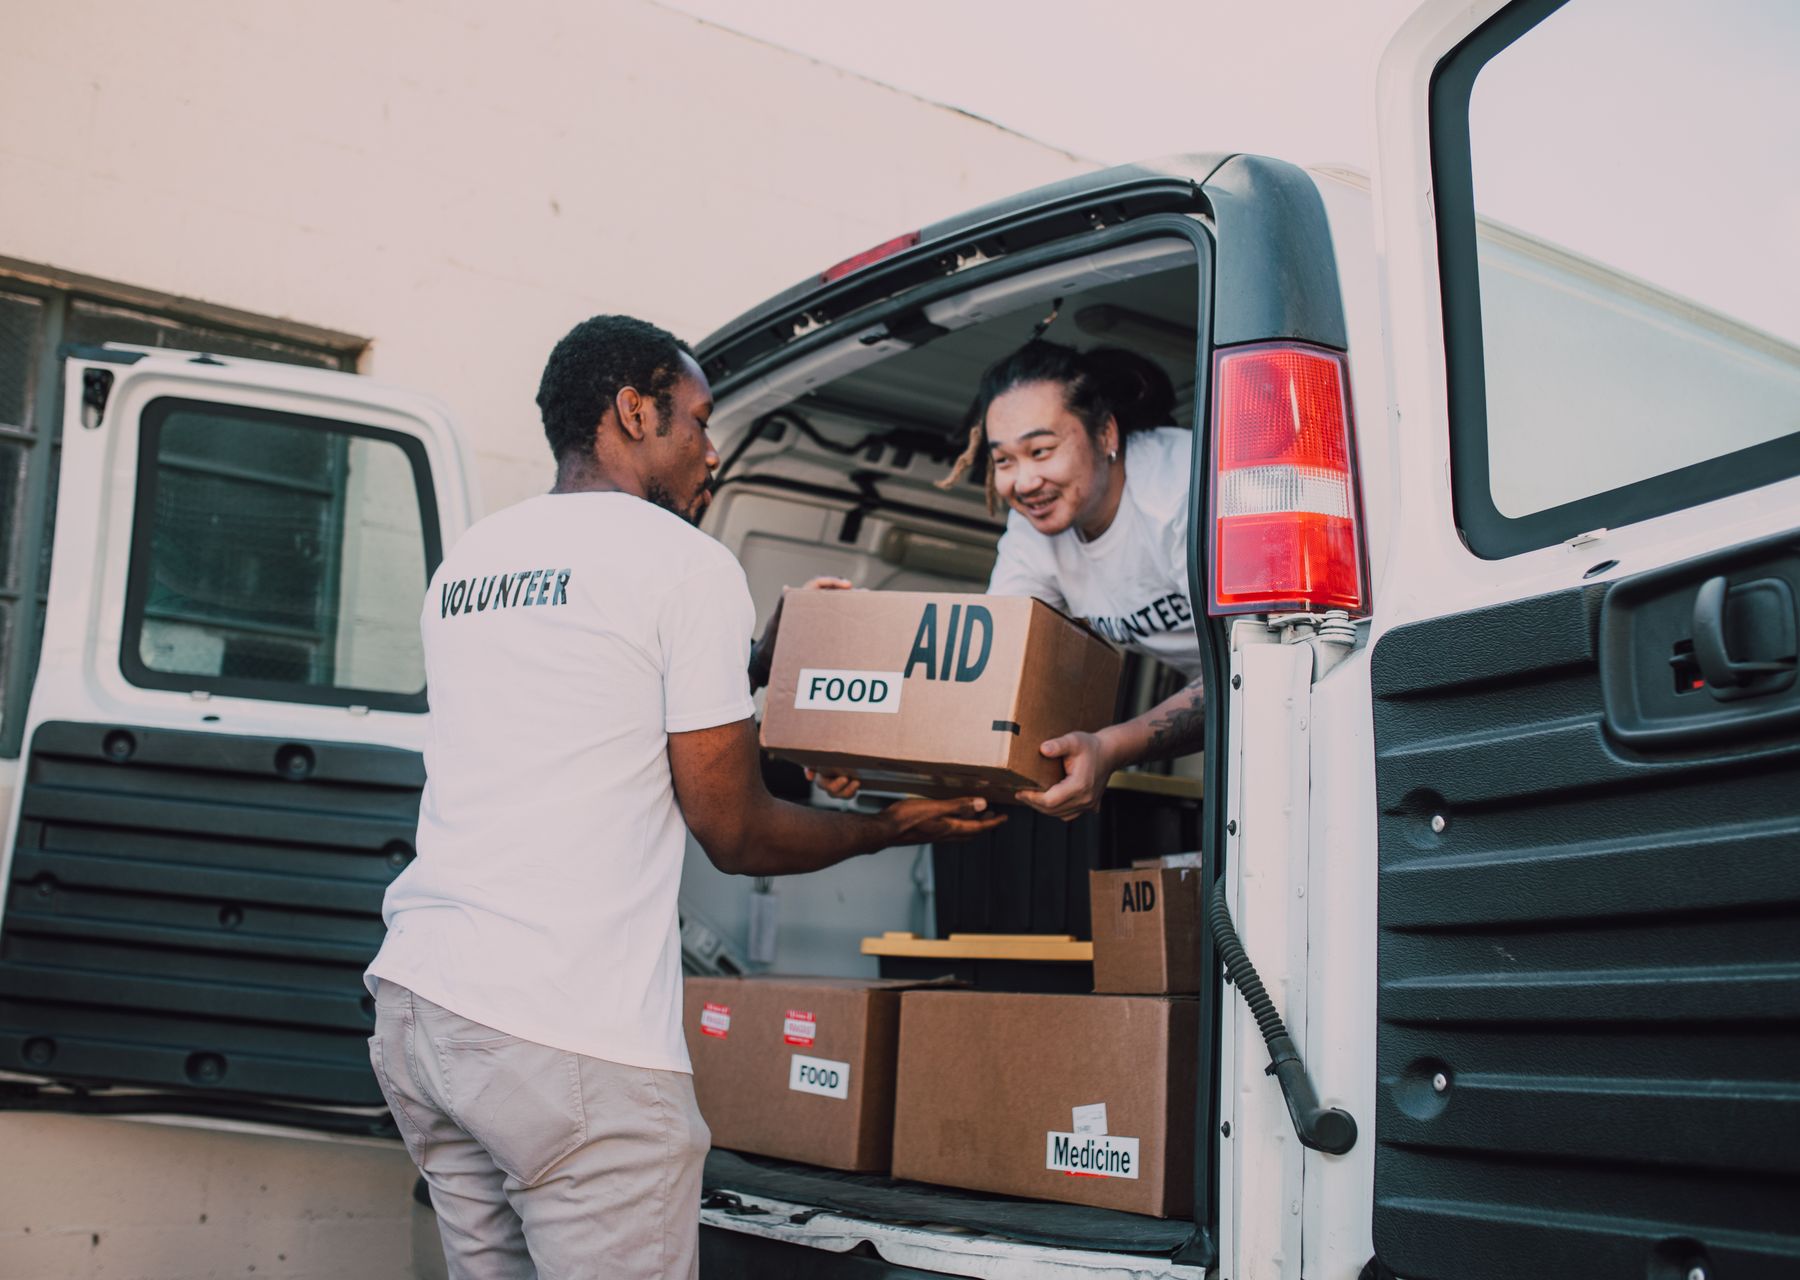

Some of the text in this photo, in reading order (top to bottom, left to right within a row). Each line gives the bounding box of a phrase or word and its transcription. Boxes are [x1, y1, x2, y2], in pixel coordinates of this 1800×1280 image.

[441, 568, 572, 619] VOLUNTEER
[904, 603, 994, 683] AID
[809, 677, 889, 703] FOOD
[1121, 881, 1156, 913] AID
[800, 1065, 839, 1089] FOOD
[1053, 1136, 1131, 1174] Medicine
